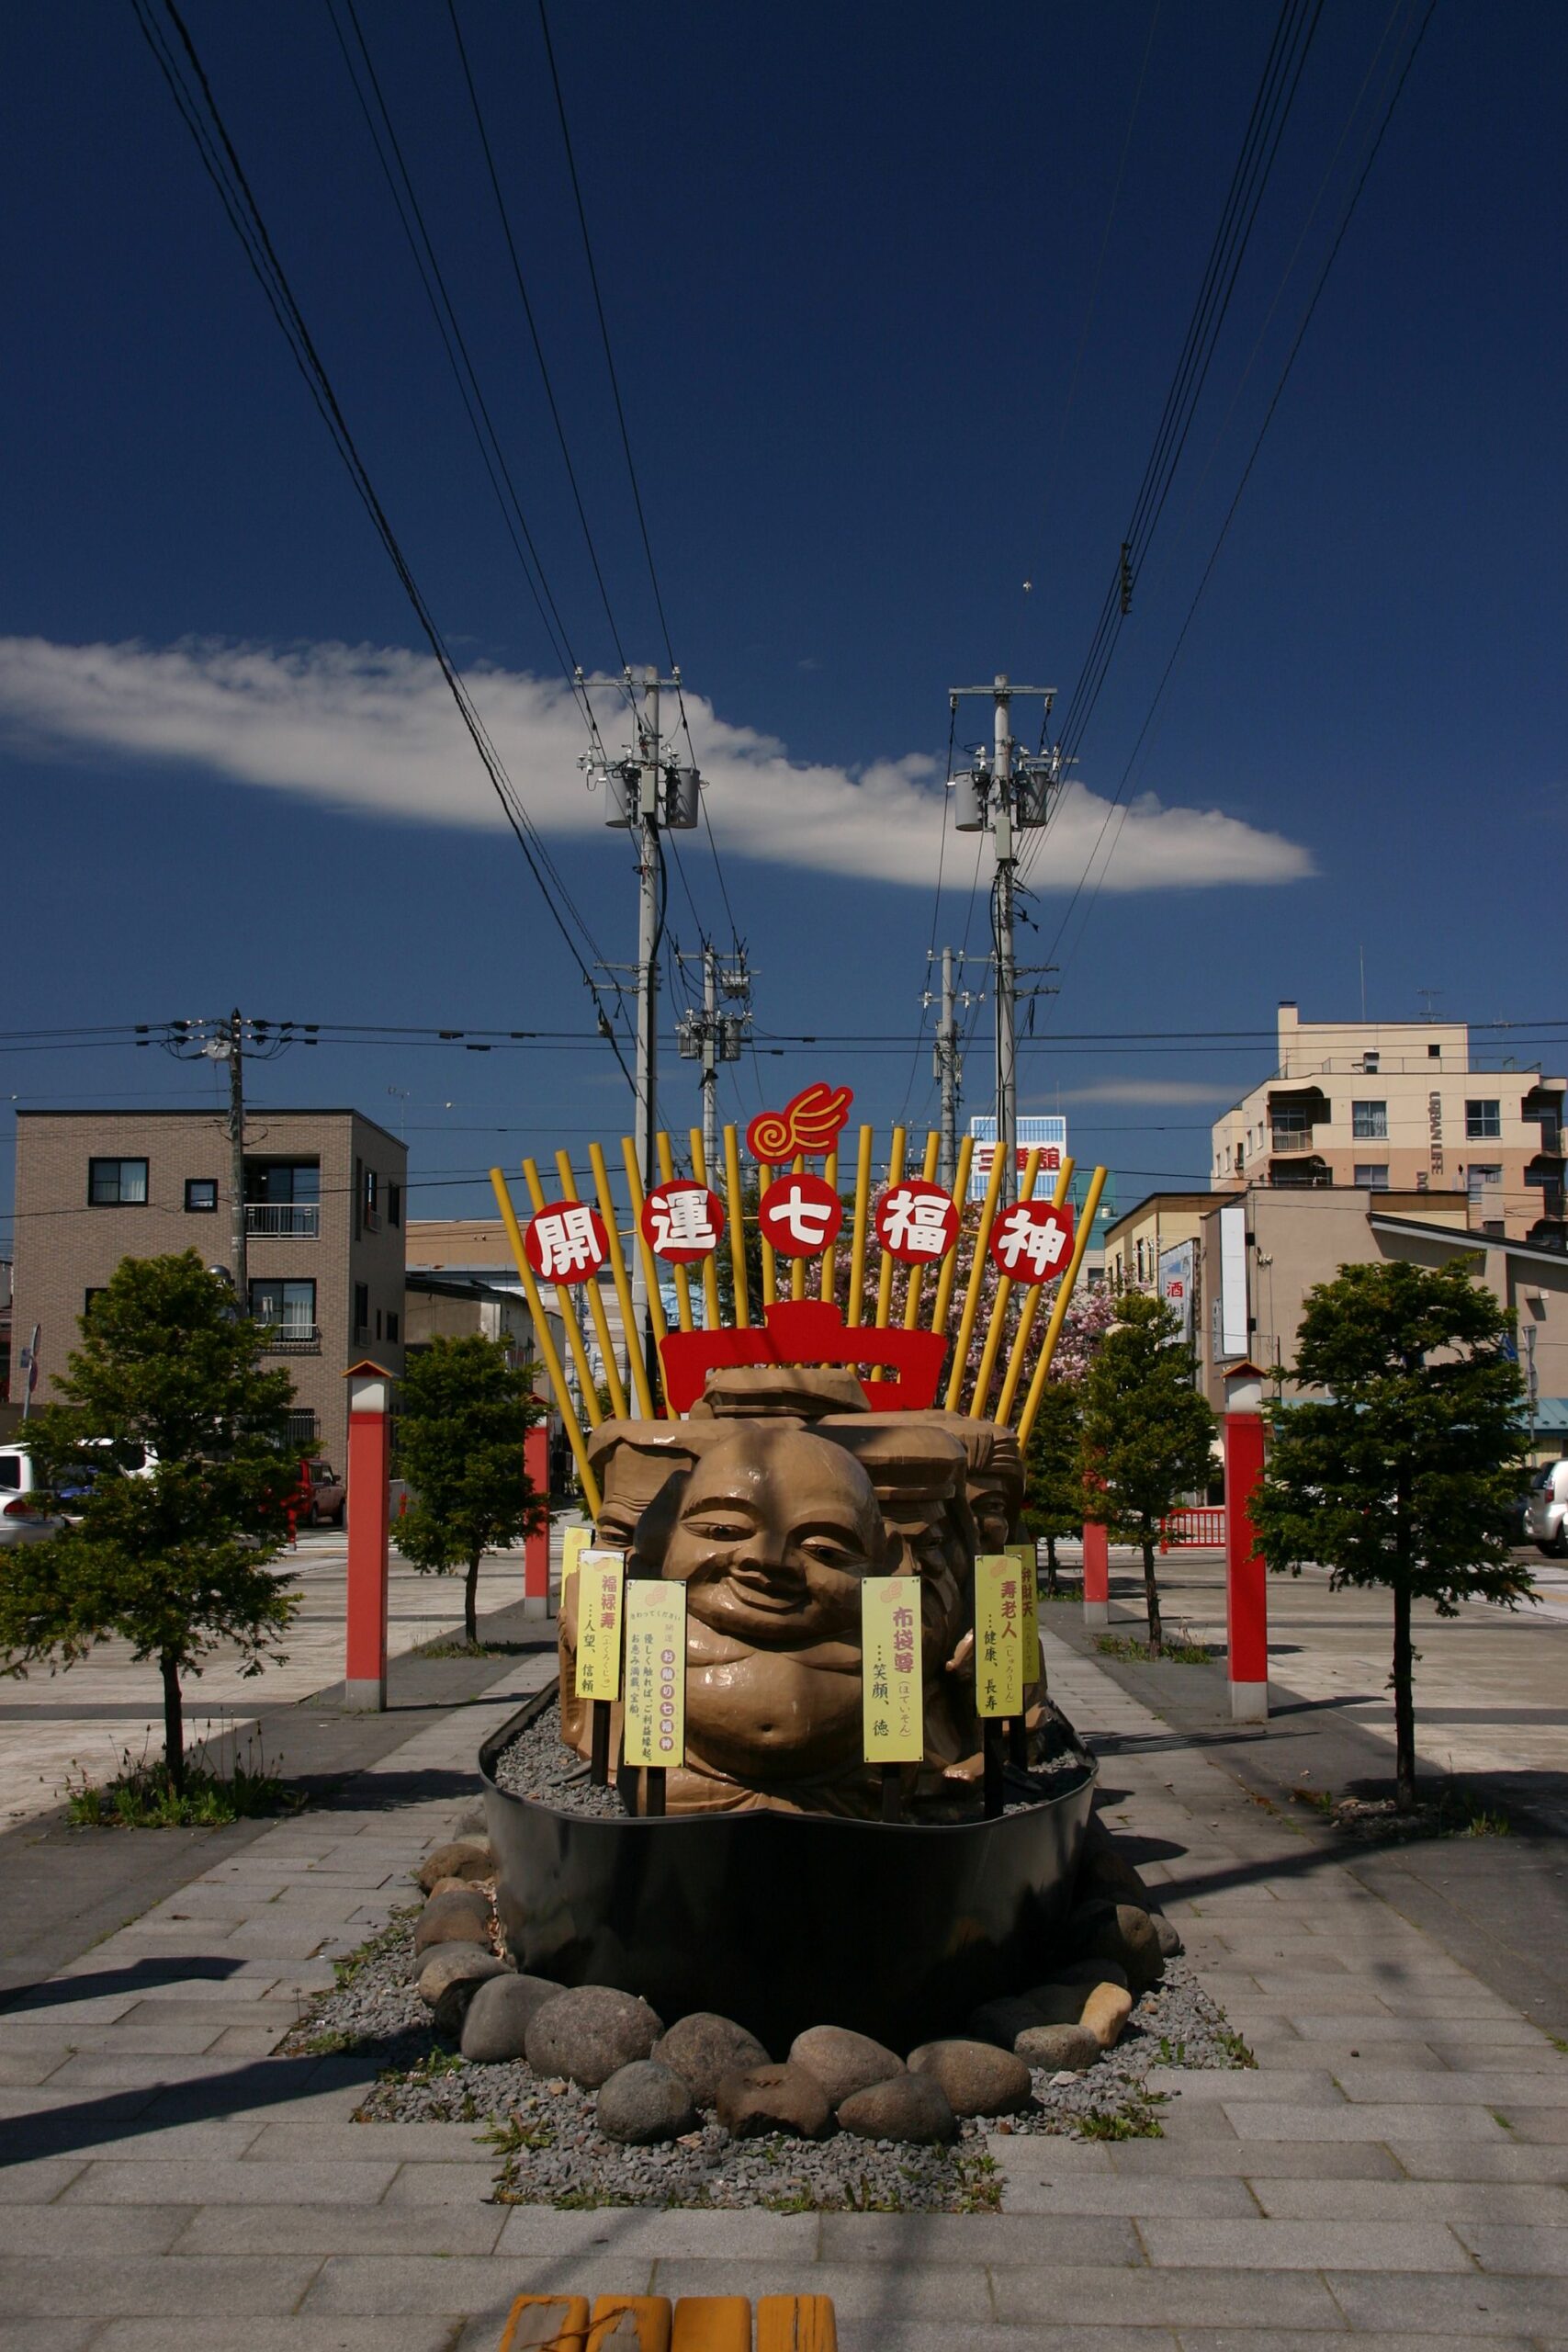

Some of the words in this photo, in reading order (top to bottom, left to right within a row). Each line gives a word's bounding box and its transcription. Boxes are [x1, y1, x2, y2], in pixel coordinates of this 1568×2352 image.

[1427, 1091, 1442, 1140] URBAN
[1430, 1143, 1443, 1175] LIFE
[533, 1184, 1066, 1277] 開運七福神
[1167, 1281, 1184, 1298] 酒
[600, 1575, 617, 1630] 福禄寿
[1000, 1580, 1018, 1639] 寿老人
[892, 1606, 914, 1674] 布袋尊
[985, 1679, 998, 1711] 長寿
[873, 1720, 889, 1737] 徳
